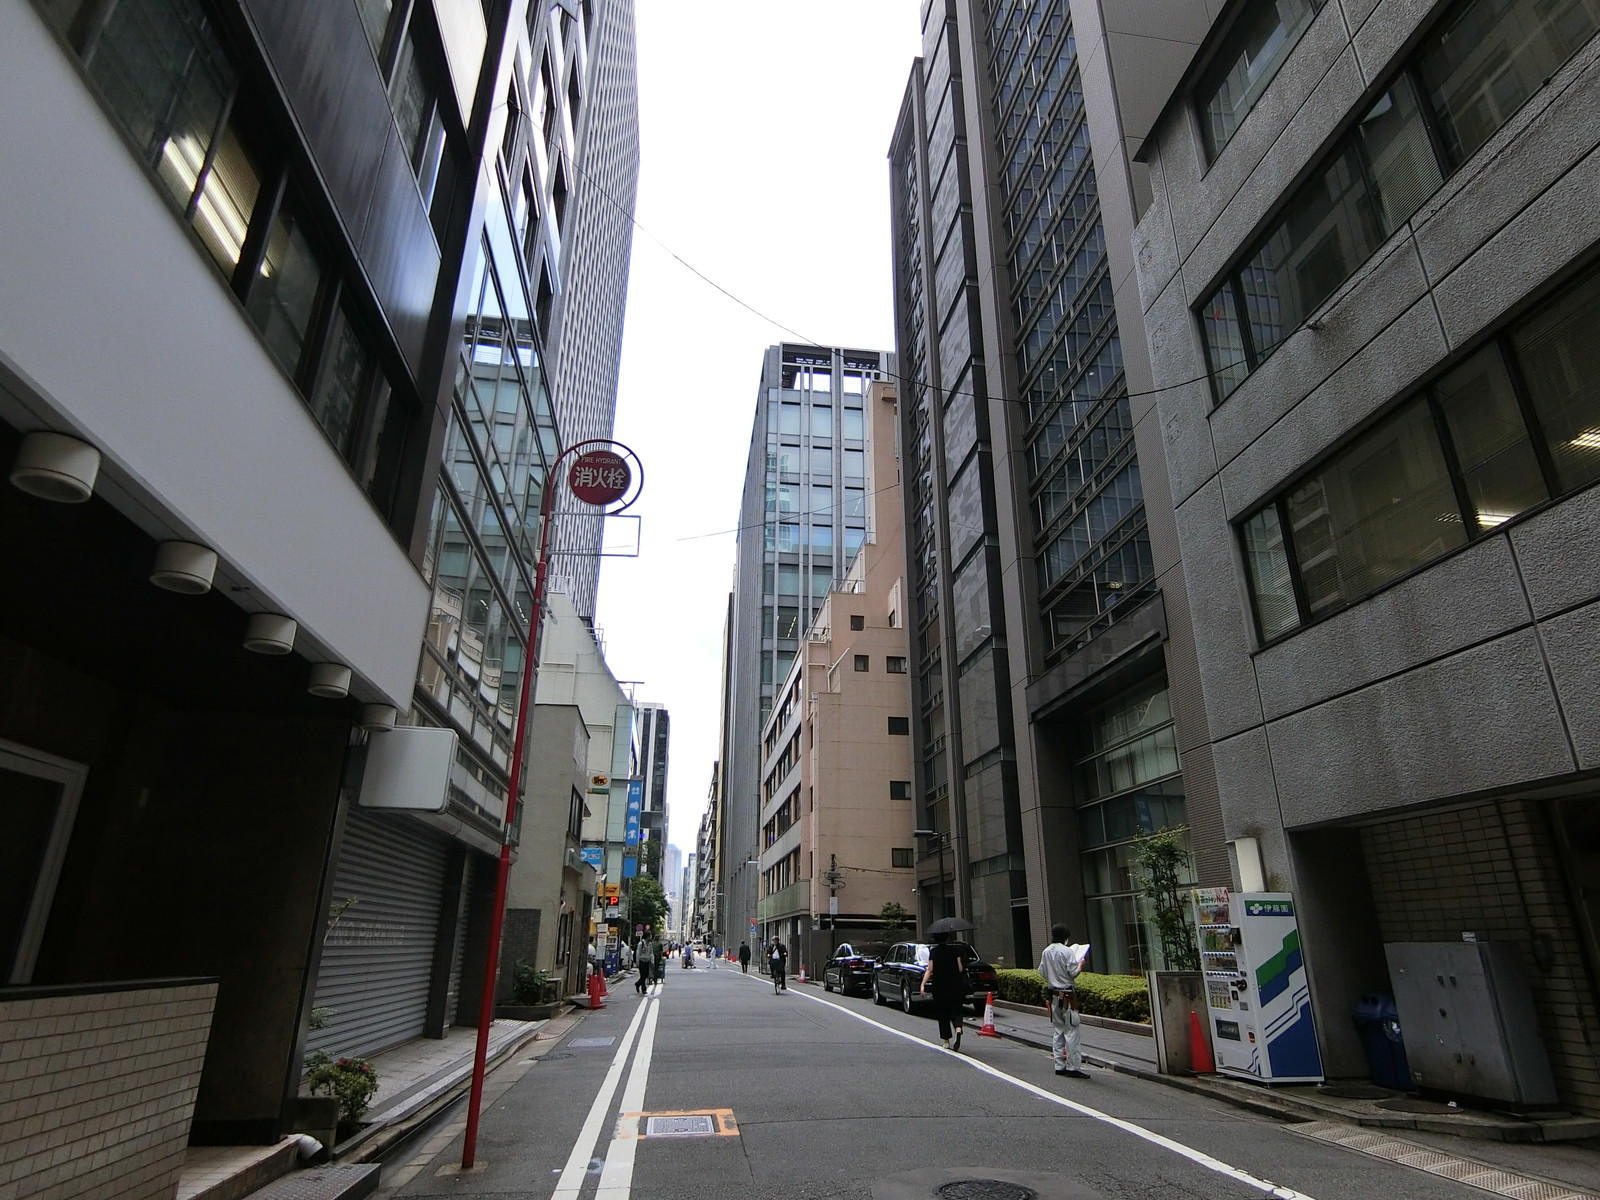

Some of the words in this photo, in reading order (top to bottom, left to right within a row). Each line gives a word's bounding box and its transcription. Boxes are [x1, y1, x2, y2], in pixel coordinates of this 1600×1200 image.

[596, 457, 622, 465] HYDRANT
[574, 466, 627, 490] 消火栓
[610, 897, 618, 905] P
[1263, 904, 1289, 913] 伊藤園
[358, 923, 406, 945] PARKING
